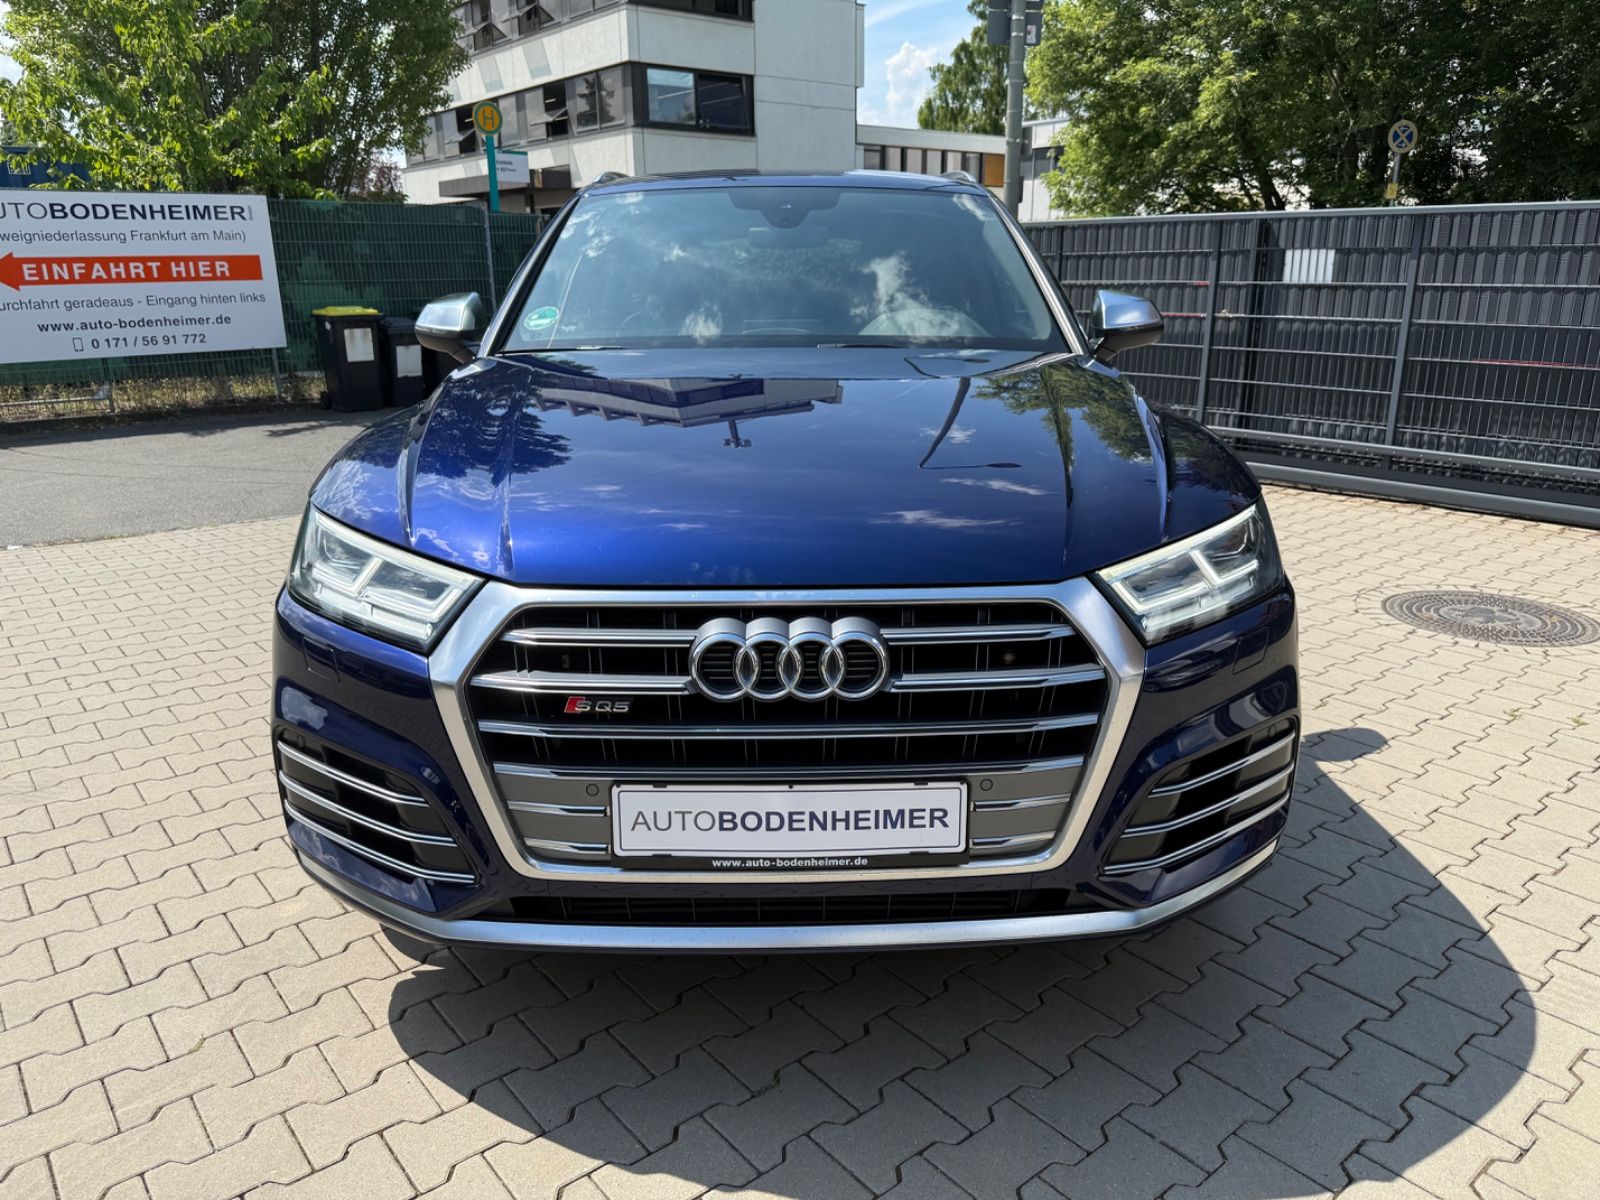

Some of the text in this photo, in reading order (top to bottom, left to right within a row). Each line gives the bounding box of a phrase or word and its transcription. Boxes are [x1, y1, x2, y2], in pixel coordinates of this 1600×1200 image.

[482, 109, 495, 128] H
[130, 230, 187, 242] Frankfurt
[191, 232, 210, 242] am
[213, 230, 246, 243] Main)
[21, 260, 231, 281] EINFAHRT HIER
[63, 297, 134, 311] geradeaus
[146, 295, 197, 307] Eingang
[200, 293, 237, 304] hinten
[240, 293, 266, 303] links
[37, 314, 232, 333] www.auto-bodenheimer.de
[141, 335, 159, 346] 56
[162, 334, 178, 345] 91
[182, 333, 207, 344] 772
[631, 808, 950, 832] AUTOBODENHEIMER
[712, 857, 869, 867] www.auto-bodenheimer.de
